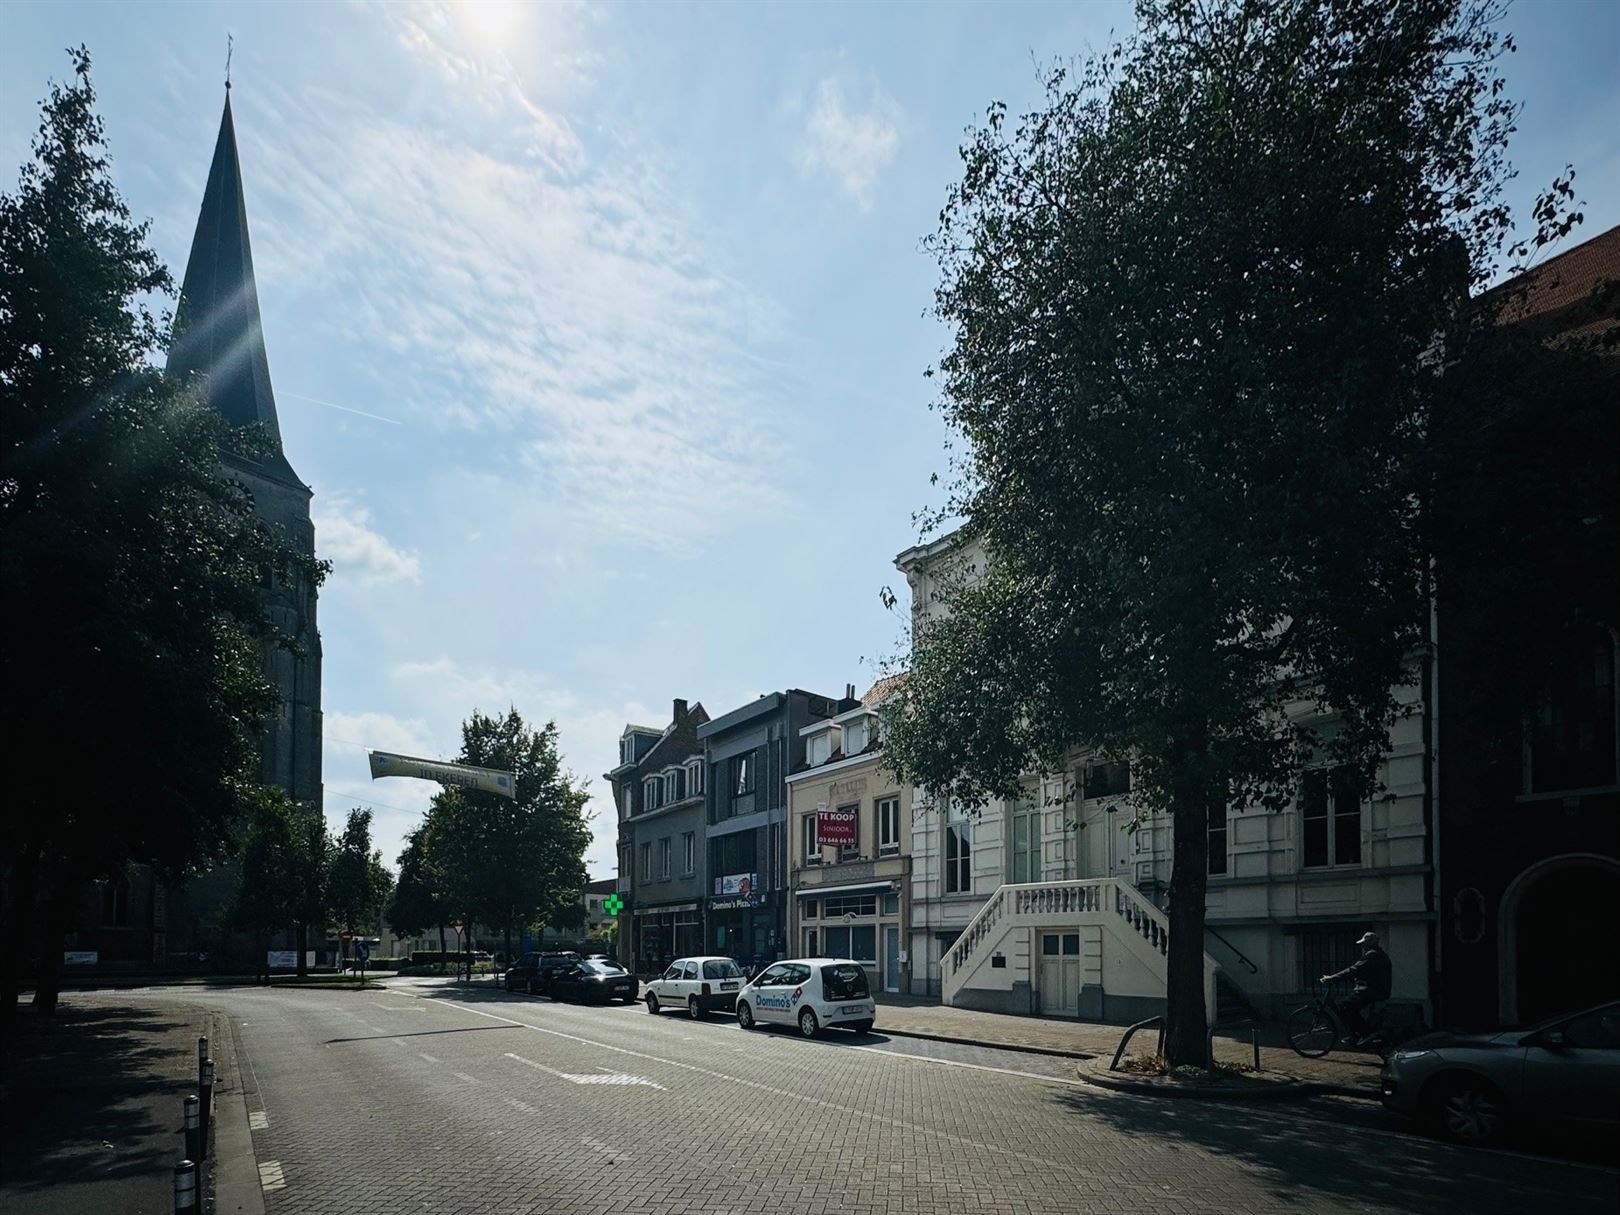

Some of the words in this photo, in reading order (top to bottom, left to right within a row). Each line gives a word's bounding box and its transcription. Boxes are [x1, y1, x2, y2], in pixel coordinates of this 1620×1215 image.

[818, 812, 829, 821] TE
[830, 812, 855, 822] KOOP
[713, 900, 736, 910] Domino's
[756, 994, 791, 1008] Domino's
